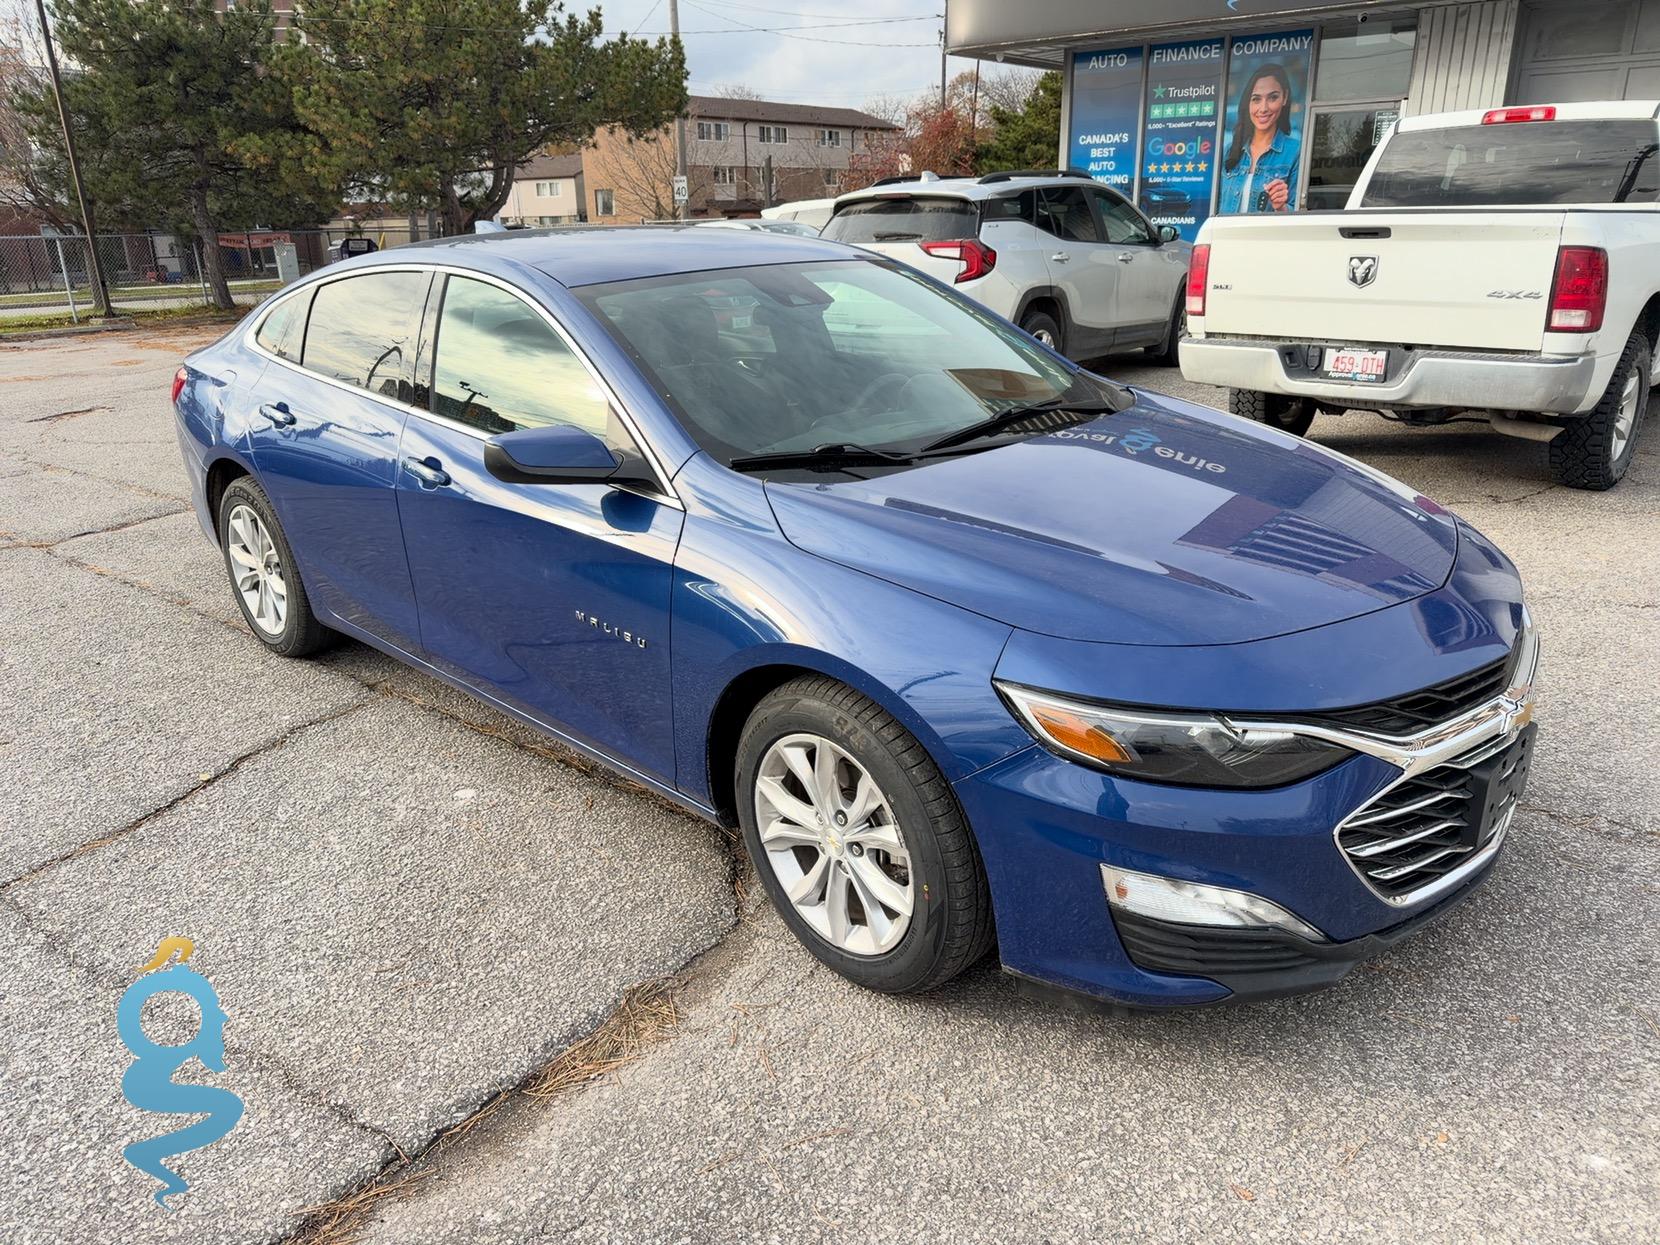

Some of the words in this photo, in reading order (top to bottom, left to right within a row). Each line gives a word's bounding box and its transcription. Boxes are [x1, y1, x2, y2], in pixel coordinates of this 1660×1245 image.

[1089, 53, 1127, 70] AUTO
[1153, 44, 1221, 63] FINANCE
[1233, 35, 1312, 56] COMPANY
[1168, 85, 1215, 98] Trustpilot
[1079, 133, 1129, 145] CANADA'S
[1090, 147, 1116, 159] BEST
[1148, 136, 1211, 160] Google
[1088, 161, 1116, 172] AUTO
[675, 186, 687, 197] 40
[1150, 216, 1196, 225] CANADIANS
[575, 609, 647, 649] MALIBU
